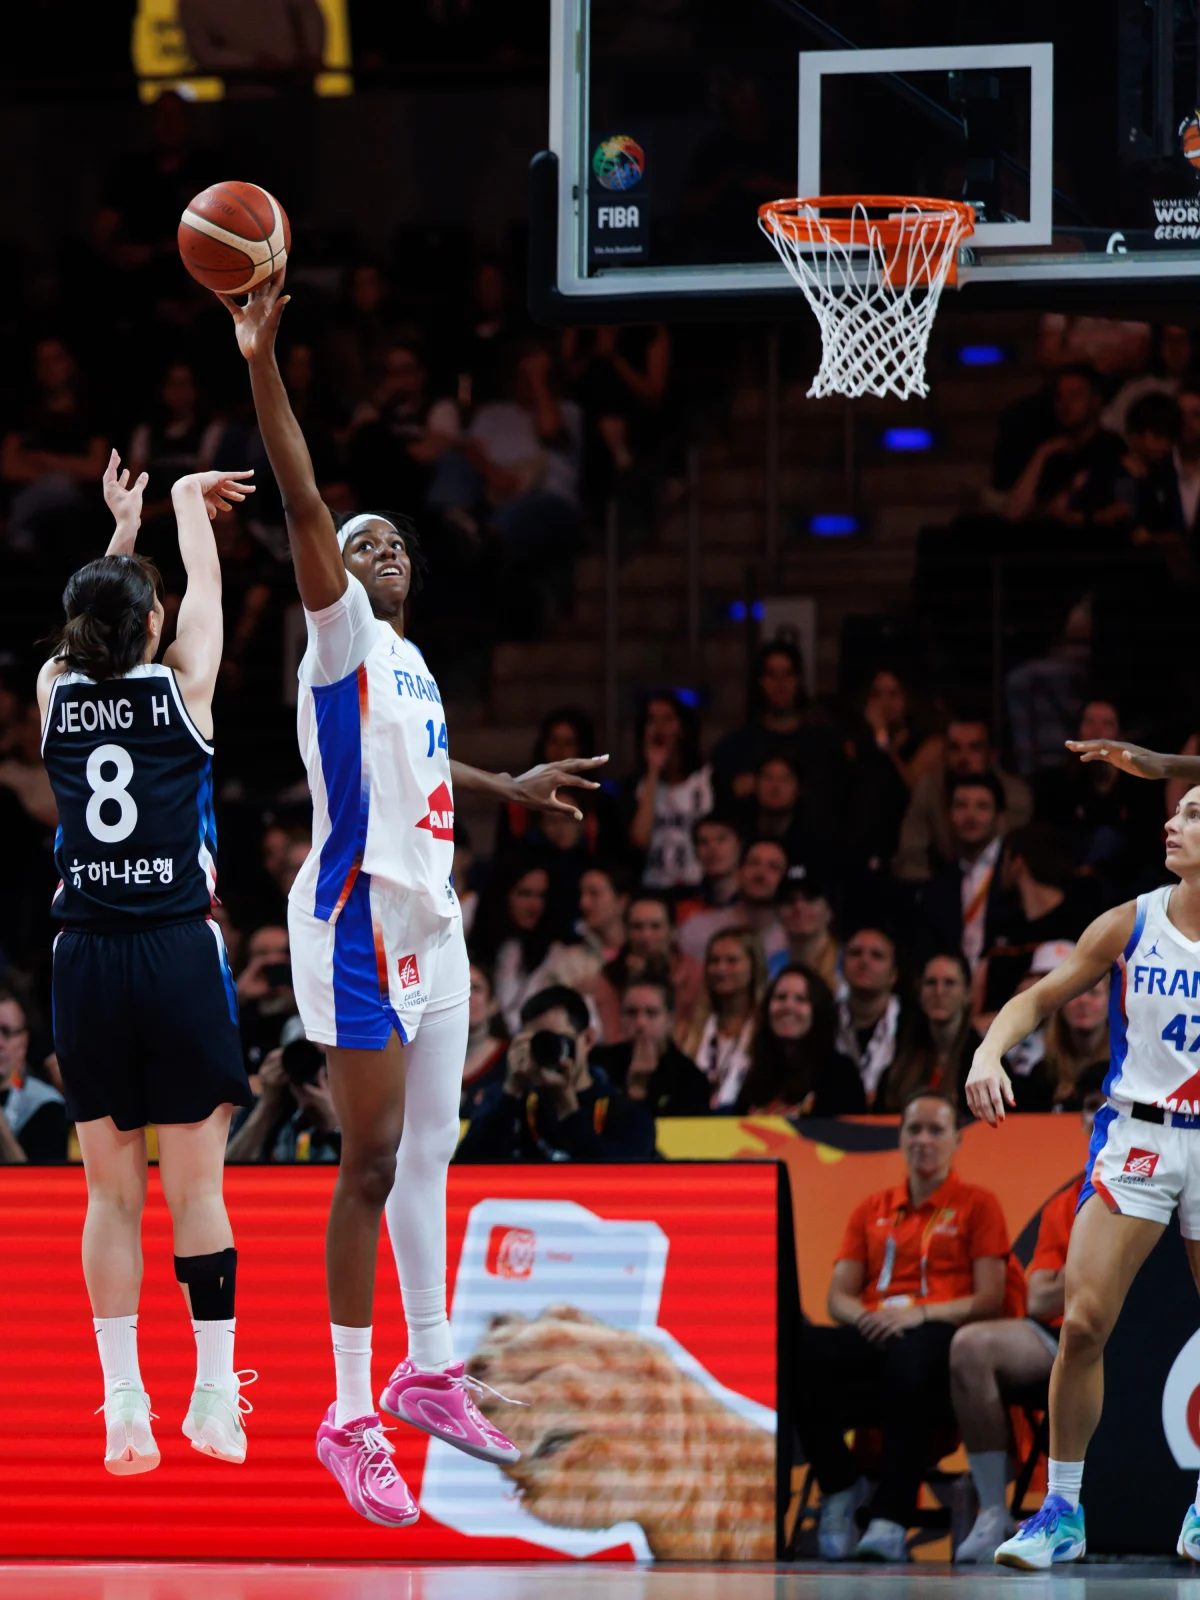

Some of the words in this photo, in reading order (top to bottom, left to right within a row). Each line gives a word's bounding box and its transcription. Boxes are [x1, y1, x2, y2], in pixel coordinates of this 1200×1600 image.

[598, 205, 639, 229] FIBA
[56, 698, 134, 734] JEONG
[152, 694, 170, 727] H
[85, 743, 138, 843] 8
[87, 857, 173, 886] 하나은행
